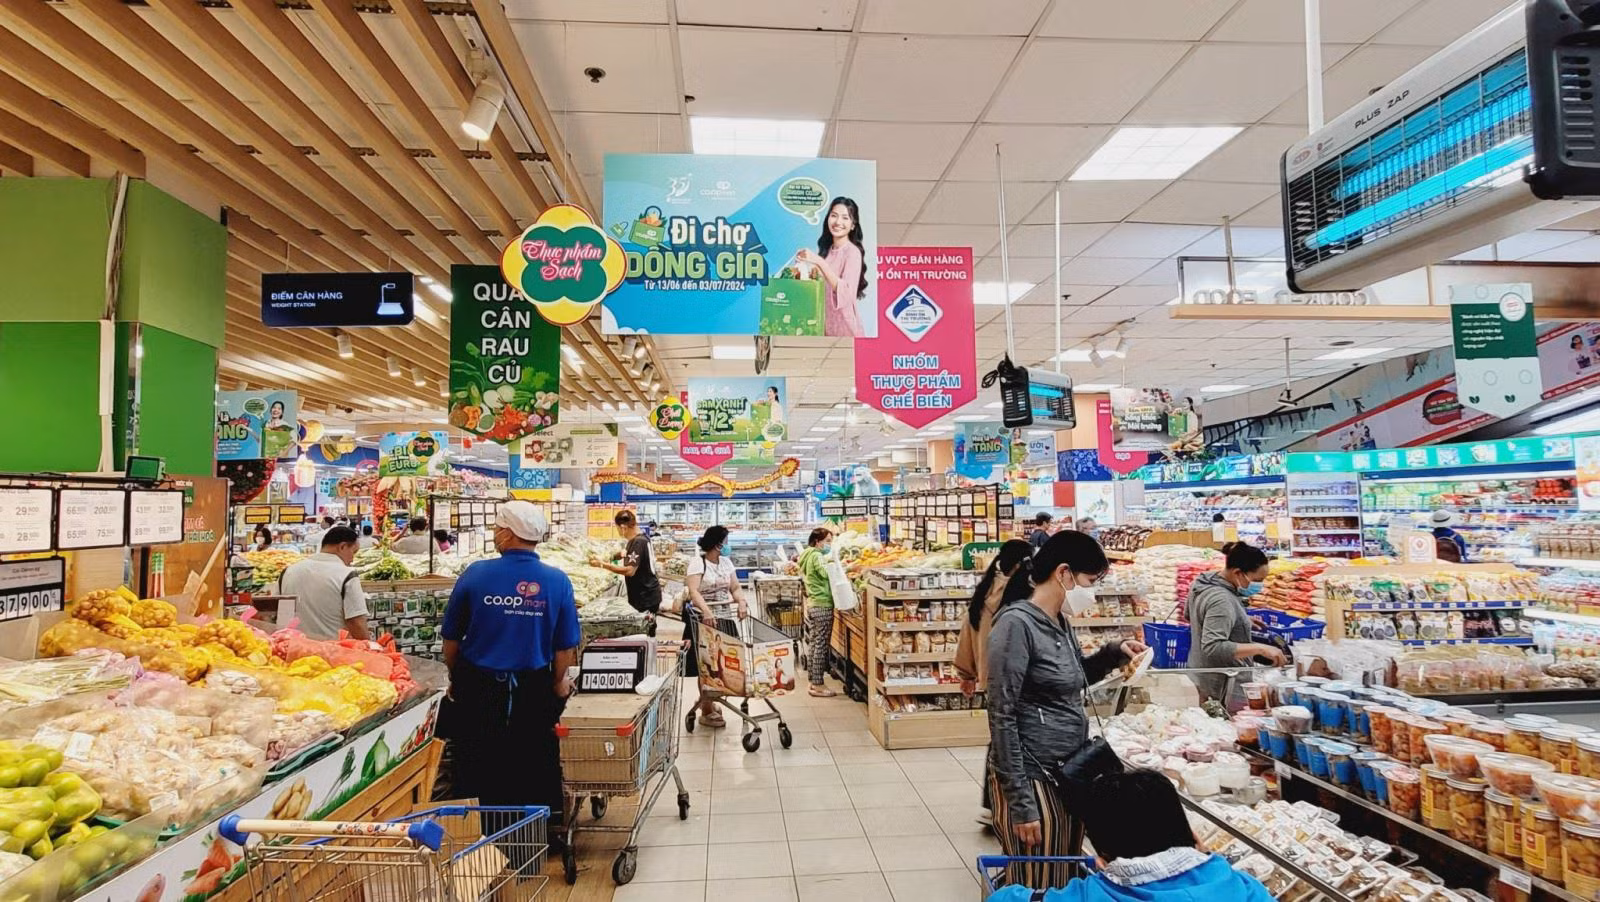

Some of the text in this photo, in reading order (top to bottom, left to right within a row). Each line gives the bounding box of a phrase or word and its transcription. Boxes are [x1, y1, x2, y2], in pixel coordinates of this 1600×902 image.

[1354, 90, 1410, 129] PLUS ZAP
[671, 218, 751, 251] Đi chợ
[885, 256, 908, 266] VỰC
[910, 254, 932, 265] BÁN
[934, 254, 964, 265] HÀNG
[541, 258, 582, 282] Sạch
[903, 270, 920, 282] THỊ
[921, 269, 967, 280] TRƯỜNG
[271, 291, 343, 300] ĐIỂM CÂN HÀNG
[658, 280, 680, 291] 13/06
[682, 280, 698, 292] đến
[699, 281, 746, 292] 03/07/2024
[481, 306, 530, 329] CÂN
[481, 338, 529, 356] RAU
[488, 359, 521, 384] CỦ
[872, 370, 961, 391] THỰC PHẨM
[882, 390, 951, 407] CHẾ BIẾN
